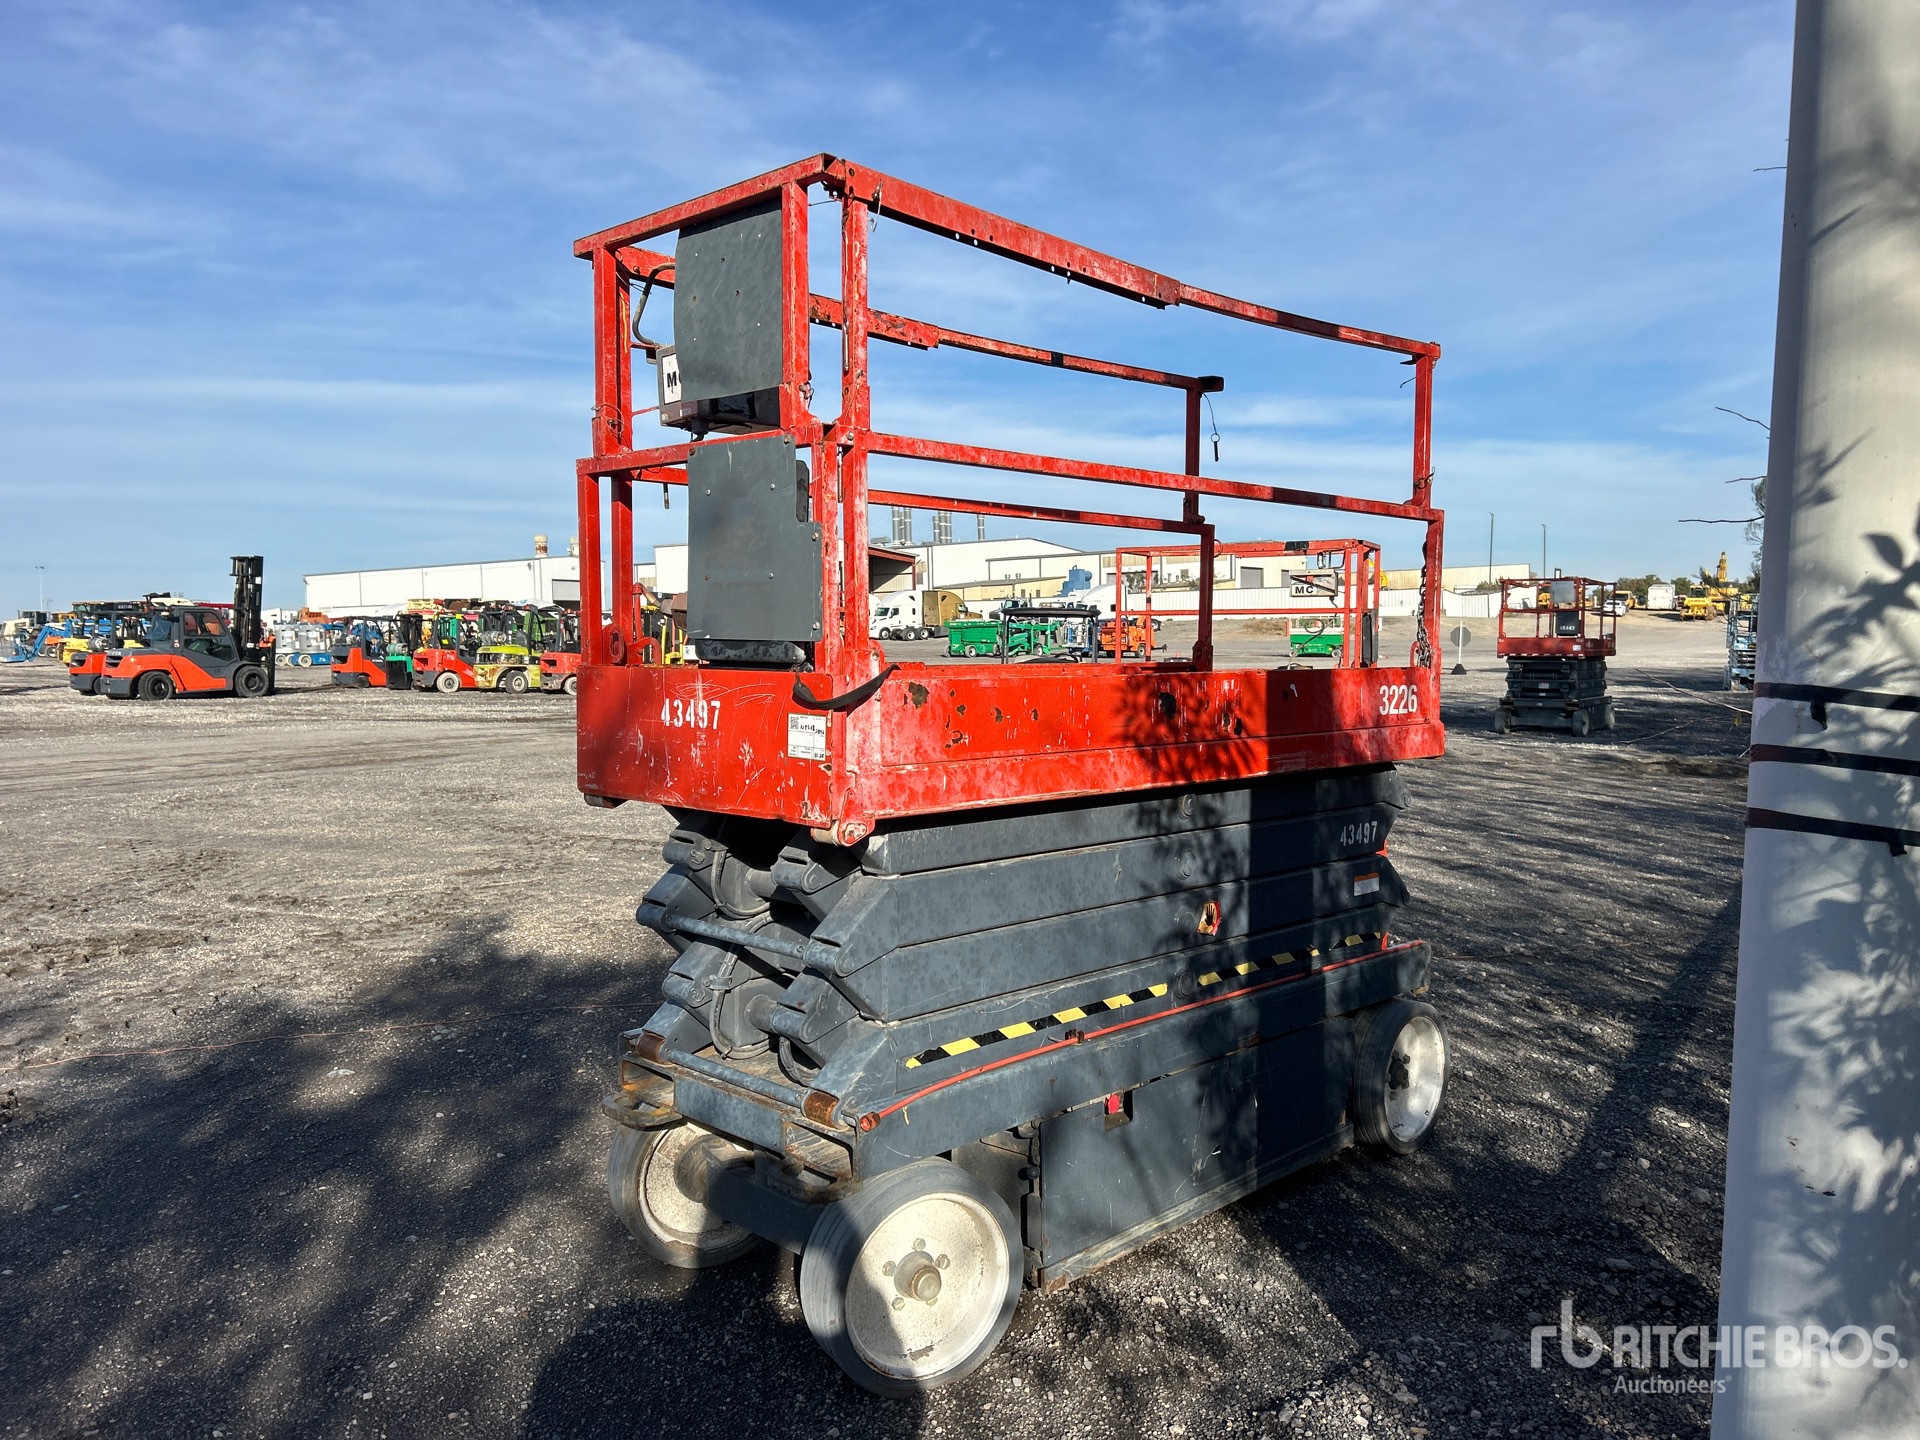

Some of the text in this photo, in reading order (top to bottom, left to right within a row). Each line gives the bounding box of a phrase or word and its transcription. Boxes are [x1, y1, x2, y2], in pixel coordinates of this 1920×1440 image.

[666, 370, 681, 389] M
[1294, 585, 1314, 594] MC
[1379, 684, 1418, 716] 3226
[660, 698, 721, 730] 43497
[1340, 820, 1378, 847] 43497
